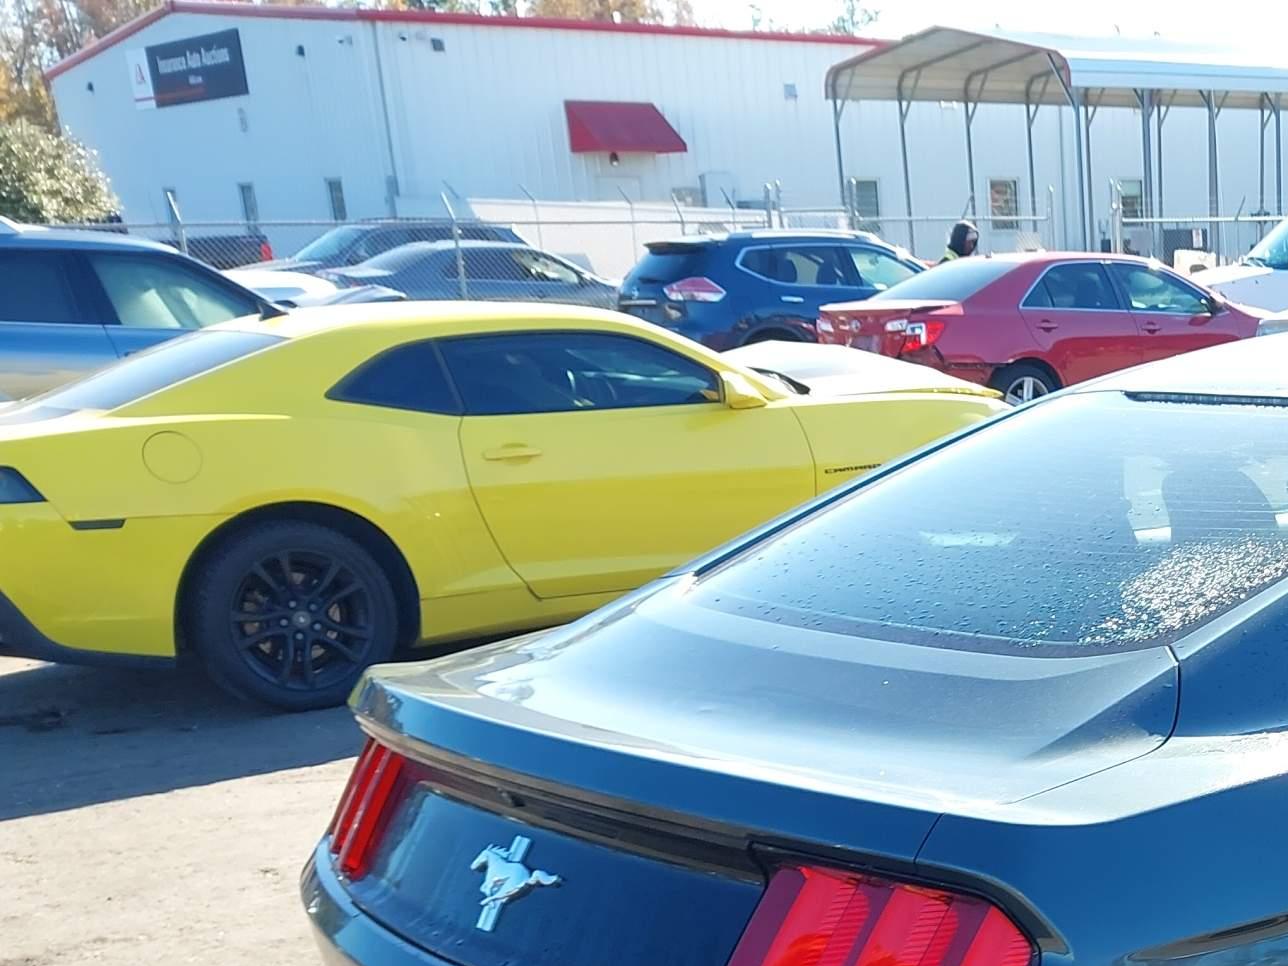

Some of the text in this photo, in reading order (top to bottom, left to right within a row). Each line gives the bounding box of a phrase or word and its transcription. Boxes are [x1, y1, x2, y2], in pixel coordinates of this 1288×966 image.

[156, 45, 230, 74] Insurance Auto Auctions
